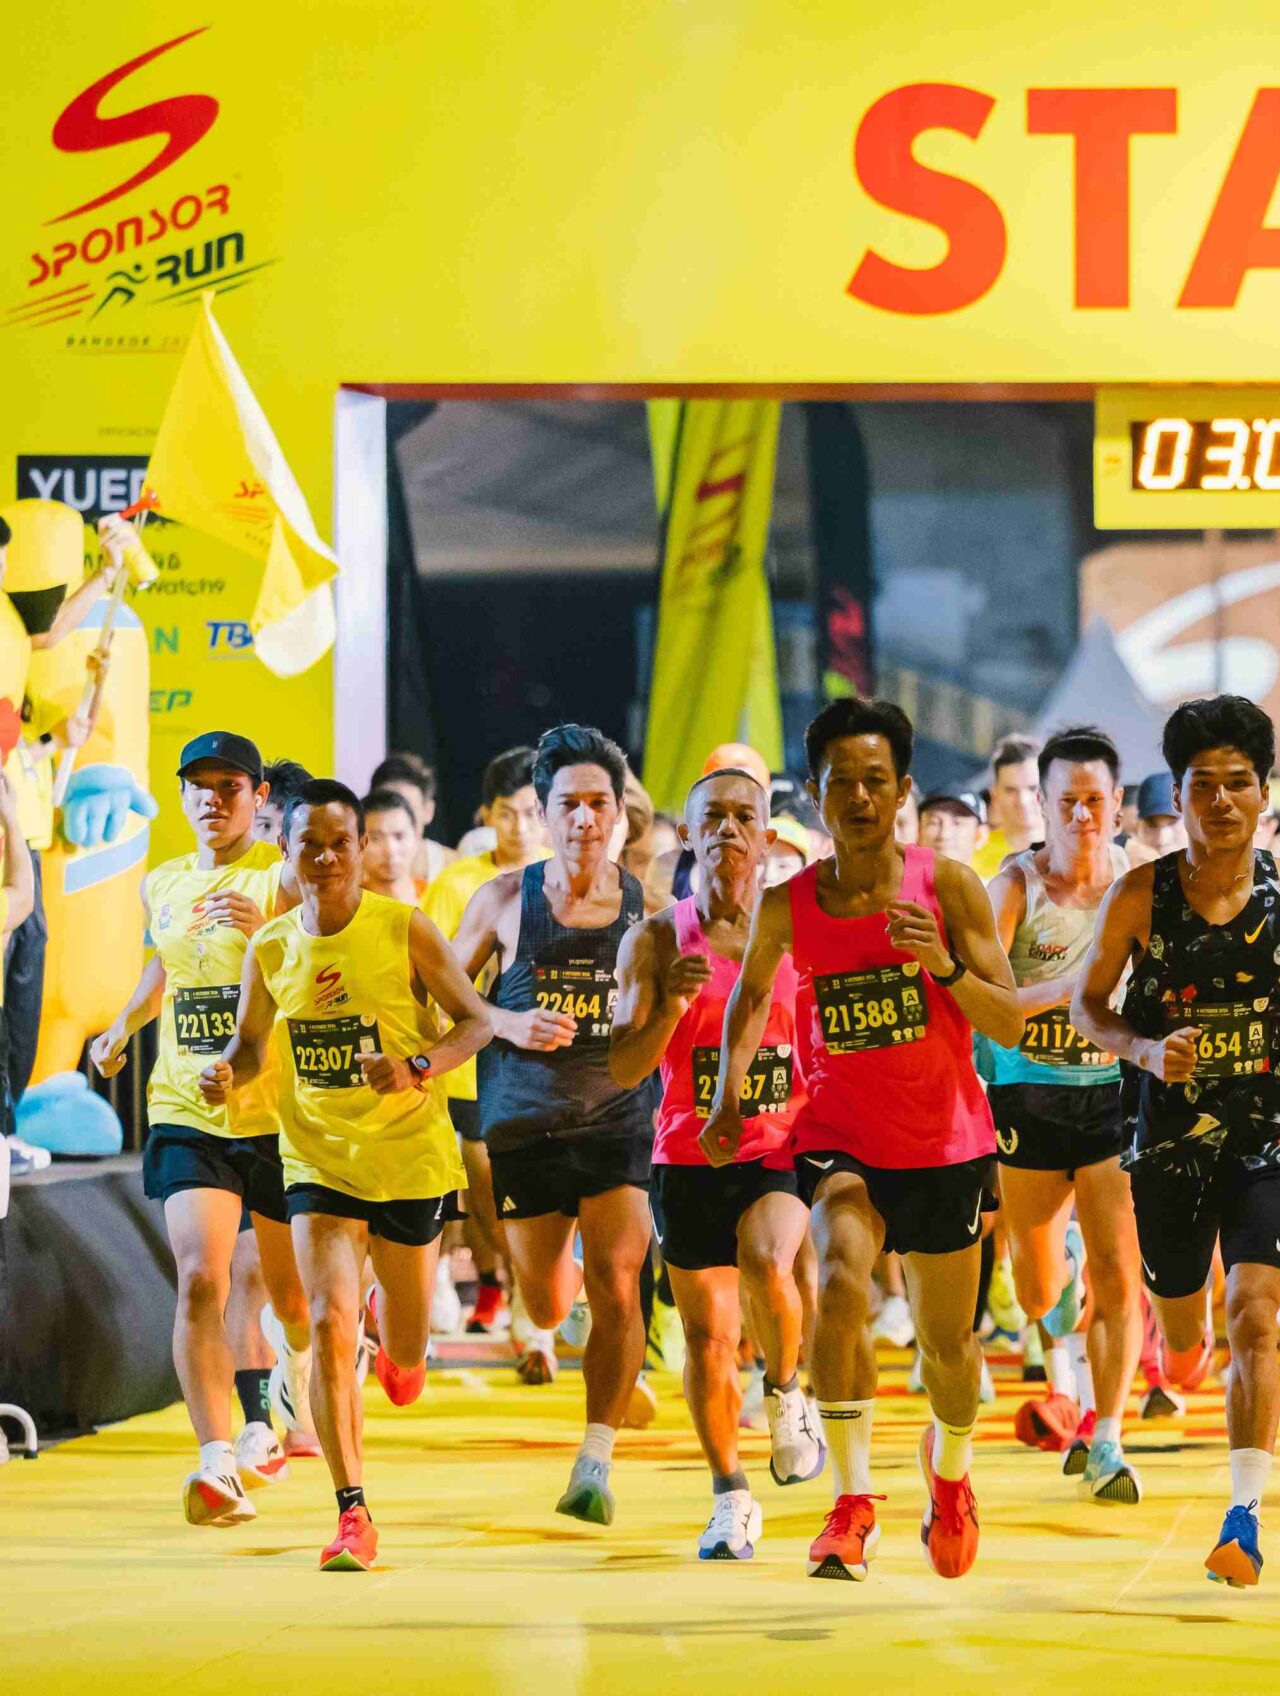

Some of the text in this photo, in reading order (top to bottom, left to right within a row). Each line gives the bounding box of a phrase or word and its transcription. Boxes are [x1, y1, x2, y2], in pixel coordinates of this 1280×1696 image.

[28, 183, 231, 287] SPONSOR
[155, 231, 244, 286] RUN
[536, 992, 601, 1018] 22464
[824, 998, 898, 1034] 21588
[178, 1011, 236, 1039] 22133
[296, 1045, 354, 1071] 22307
[1198, 1031, 1242, 1059] 654
